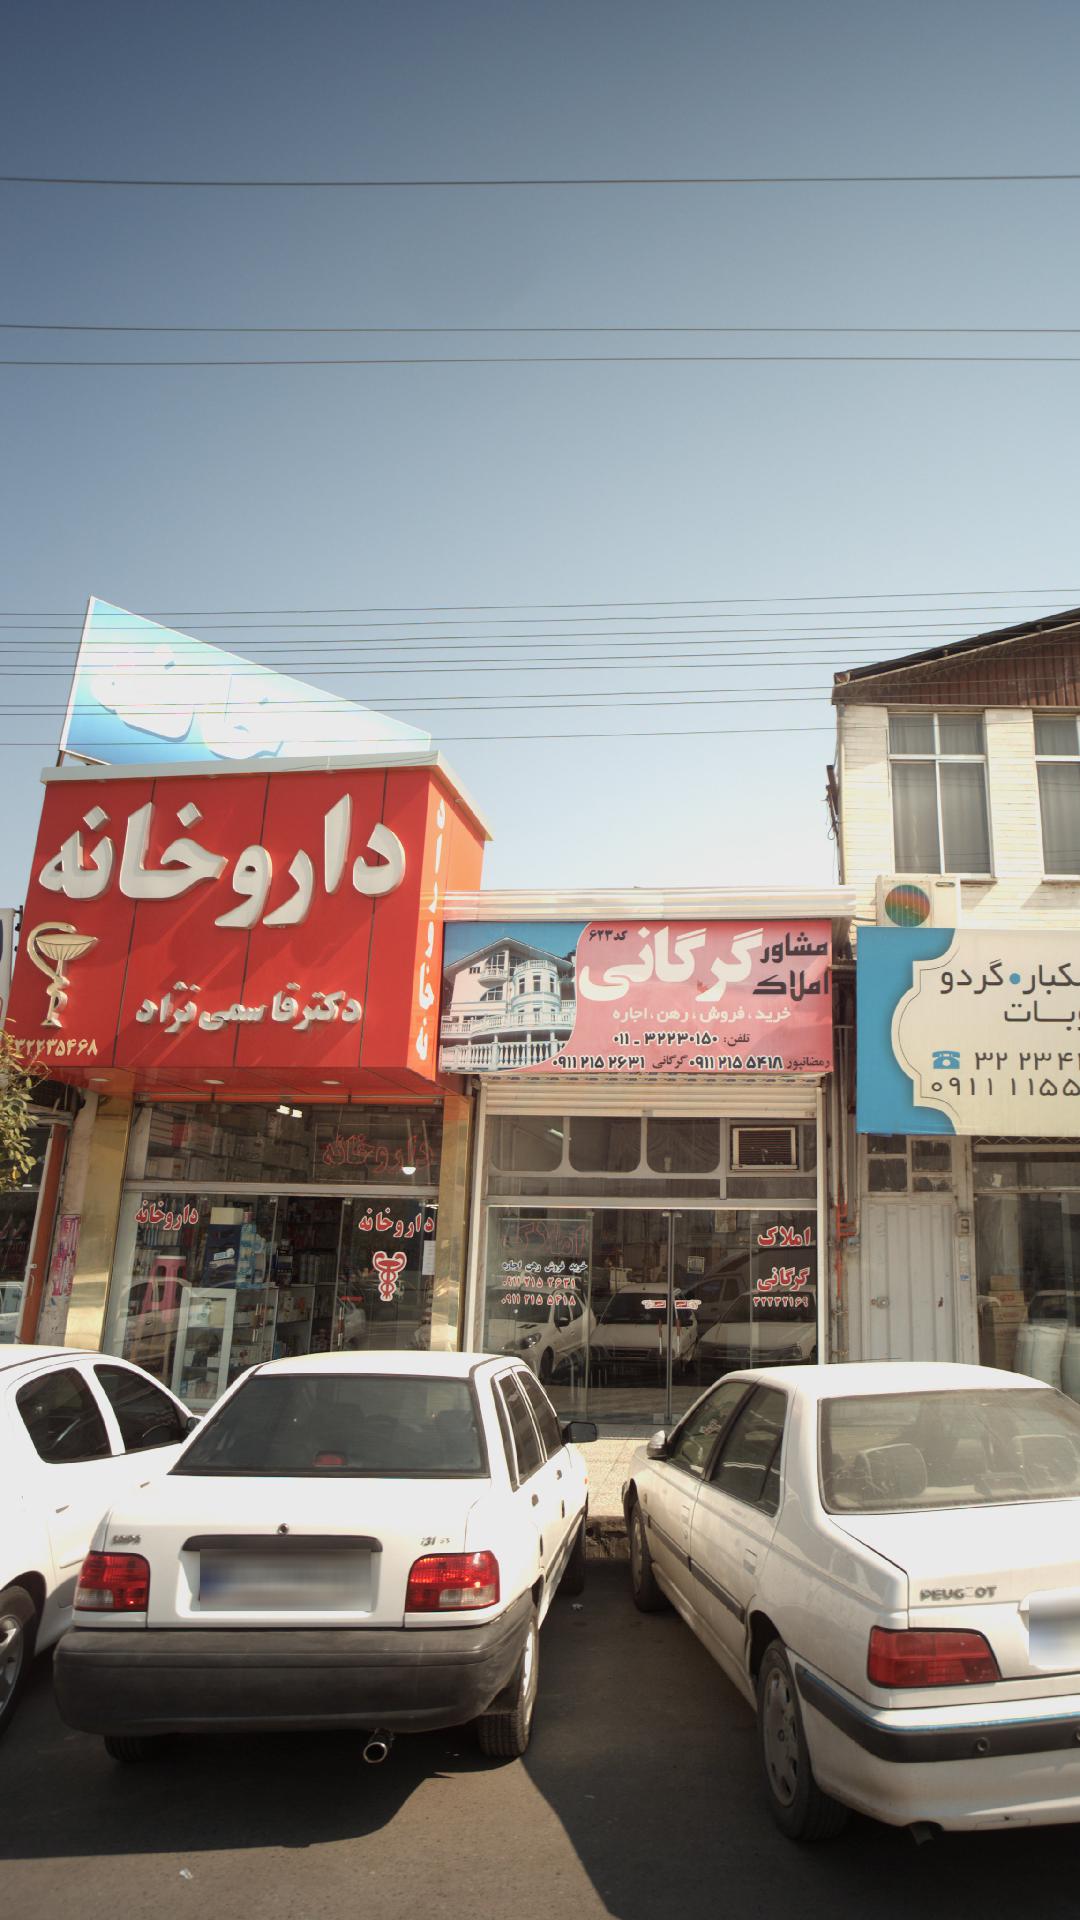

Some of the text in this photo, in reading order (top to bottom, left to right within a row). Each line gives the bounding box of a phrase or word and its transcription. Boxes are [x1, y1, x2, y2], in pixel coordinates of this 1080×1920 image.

[38, 793, 406, 929] داروخانه
[759, 931, 829, 963] مشاور
[578, 925, 764, 1003] گرگانی
[941, 958, 1080, 995] کبار گردو
[752, 968, 830, 1002] املاک
[292, 990, 362, 1031] دکتر
[612, 1007, 648, 1023] اجاره
[1003, 1000, 1080, 1032] بات
[643, 1031, 719, 1047] ۳۲۲۳۰۱۵۰
[552, 1055, 576, 1069] ۰۹۱۱
[580, 1055, 605, 1069] ۲۱۵
[608, 1055, 645, 1069] ۲۶۳۱
[689, 1055, 714, 1069] ۰۹۱۱
[718, 1055, 742, 1069] ۲۱۵
[746, 1055, 783, 1069] ۵۴۱۸
[135, 1200, 199, 1231] داروخانه
[358, 1207, 435, 1239] داروخانه
[757, 1225, 812, 1247] املاک
[757, 1266, 811, 1292] گرگانی
